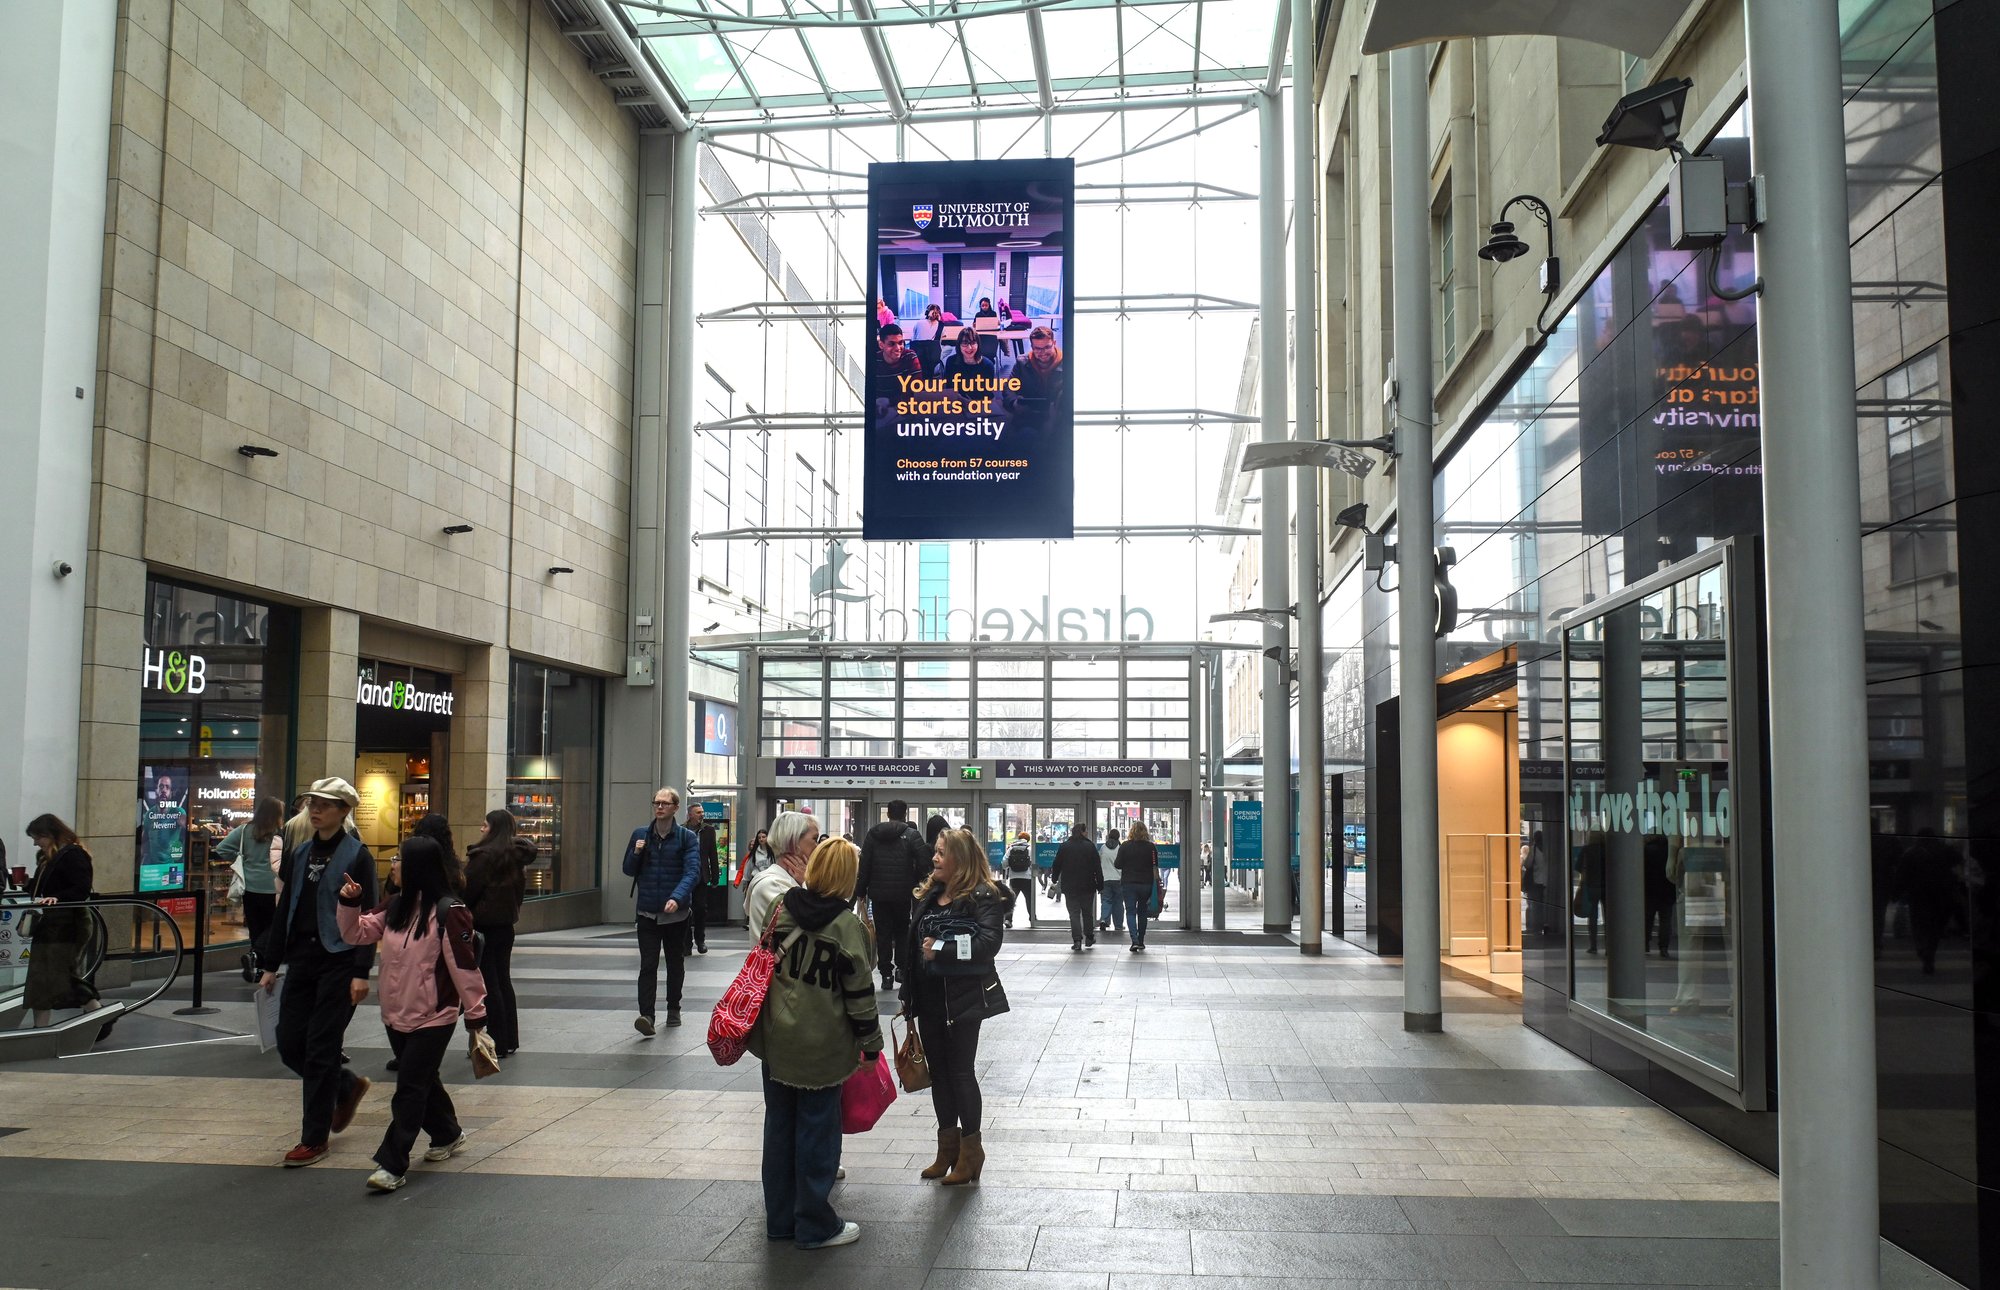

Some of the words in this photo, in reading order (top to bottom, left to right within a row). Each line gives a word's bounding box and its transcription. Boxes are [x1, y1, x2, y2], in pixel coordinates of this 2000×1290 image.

[938, 203, 1011, 214] UNIVERSITY
[1013, 202, 1030, 213] OF
[938, 213, 1030, 228] PLYMOUTH
[897, 375, 947, 393] Your
[952, 373, 1022, 392] future
[897, 396, 963, 415] starts
[967, 396, 992, 414] at
[897, 417, 1005, 441] university
[896, 459, 938, 469] Choose
[941, 458, 967, 468] from
[970, 458, 983, 468] 57
[985, 459, 1028, 467] courses
[896, 471, 921, 481] with
[922, 473, 930, 481] a
[932, 470, 993, 480] foundation
[995, 472, 1020, 482] year
[143, 647, 206, 694] H&B
[804, 764, 822, 772] THIS
[823, 764, 844, 772] WAY
[879, 765, 920, 773] BARCODE
[1024, 765, 1043, 773] THIS
[1045, 765, 1065, 773] WAY
[1068, 765, 1080, 773] TO
[1082, 765, 1098, 773] THE
[1101, 765, 1143, 773] BARCODE
[220, 770, 256, 780] Welcome
[1590, 781, 1634, 834] Love
[149, 811, 166, 819] Game
[166, 811, 182, 820] over?
